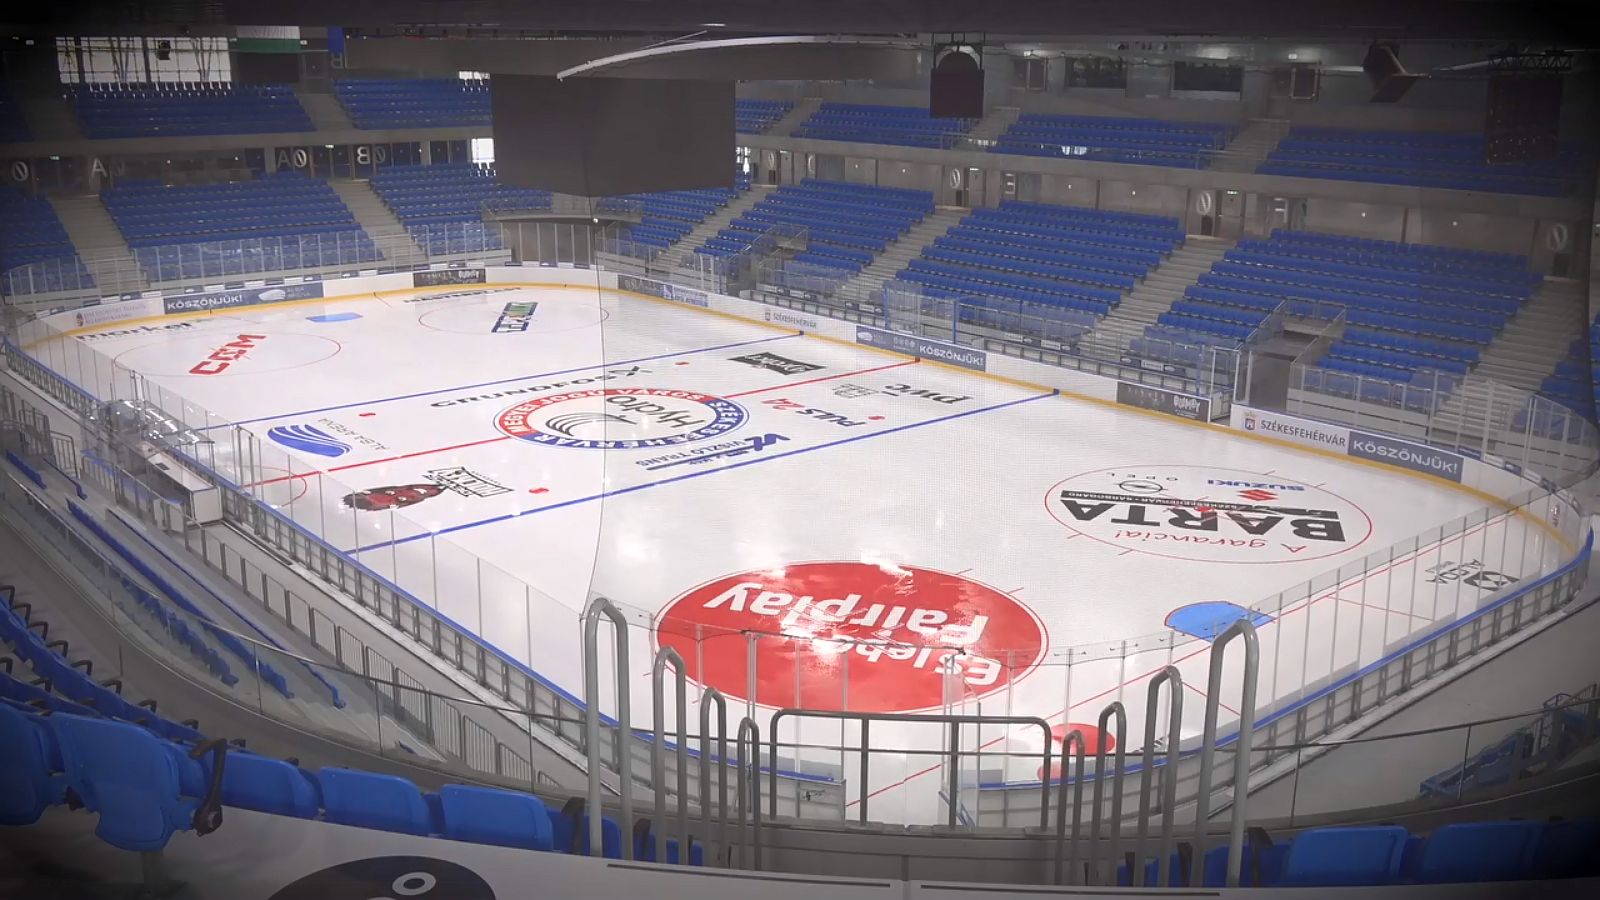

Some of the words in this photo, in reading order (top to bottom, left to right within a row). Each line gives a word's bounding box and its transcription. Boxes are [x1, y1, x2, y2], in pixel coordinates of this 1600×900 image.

[166, 294, 243, 311] KÖSZÖNJÜK!
[919, 345, 984, 367] KÖSZÖNJÜK!
[606, 395, 706, 429] Hydro
[1260, 418, 1346, 448] SZÉKESFEHÉRVÁR
[1353, 439, 1458, 474] KÖSZÖNJÜK!
[1107, 472, 1179, 482] OPEL
[1207, 479, 1305, 491] SUZUKI
[1060, 499, 1346, 542] BARTA
[1114, 530, 1267, 549] garancia!
[1281, 543, 1308, 554] A
[703, 582, 990, 645] Fairplay
